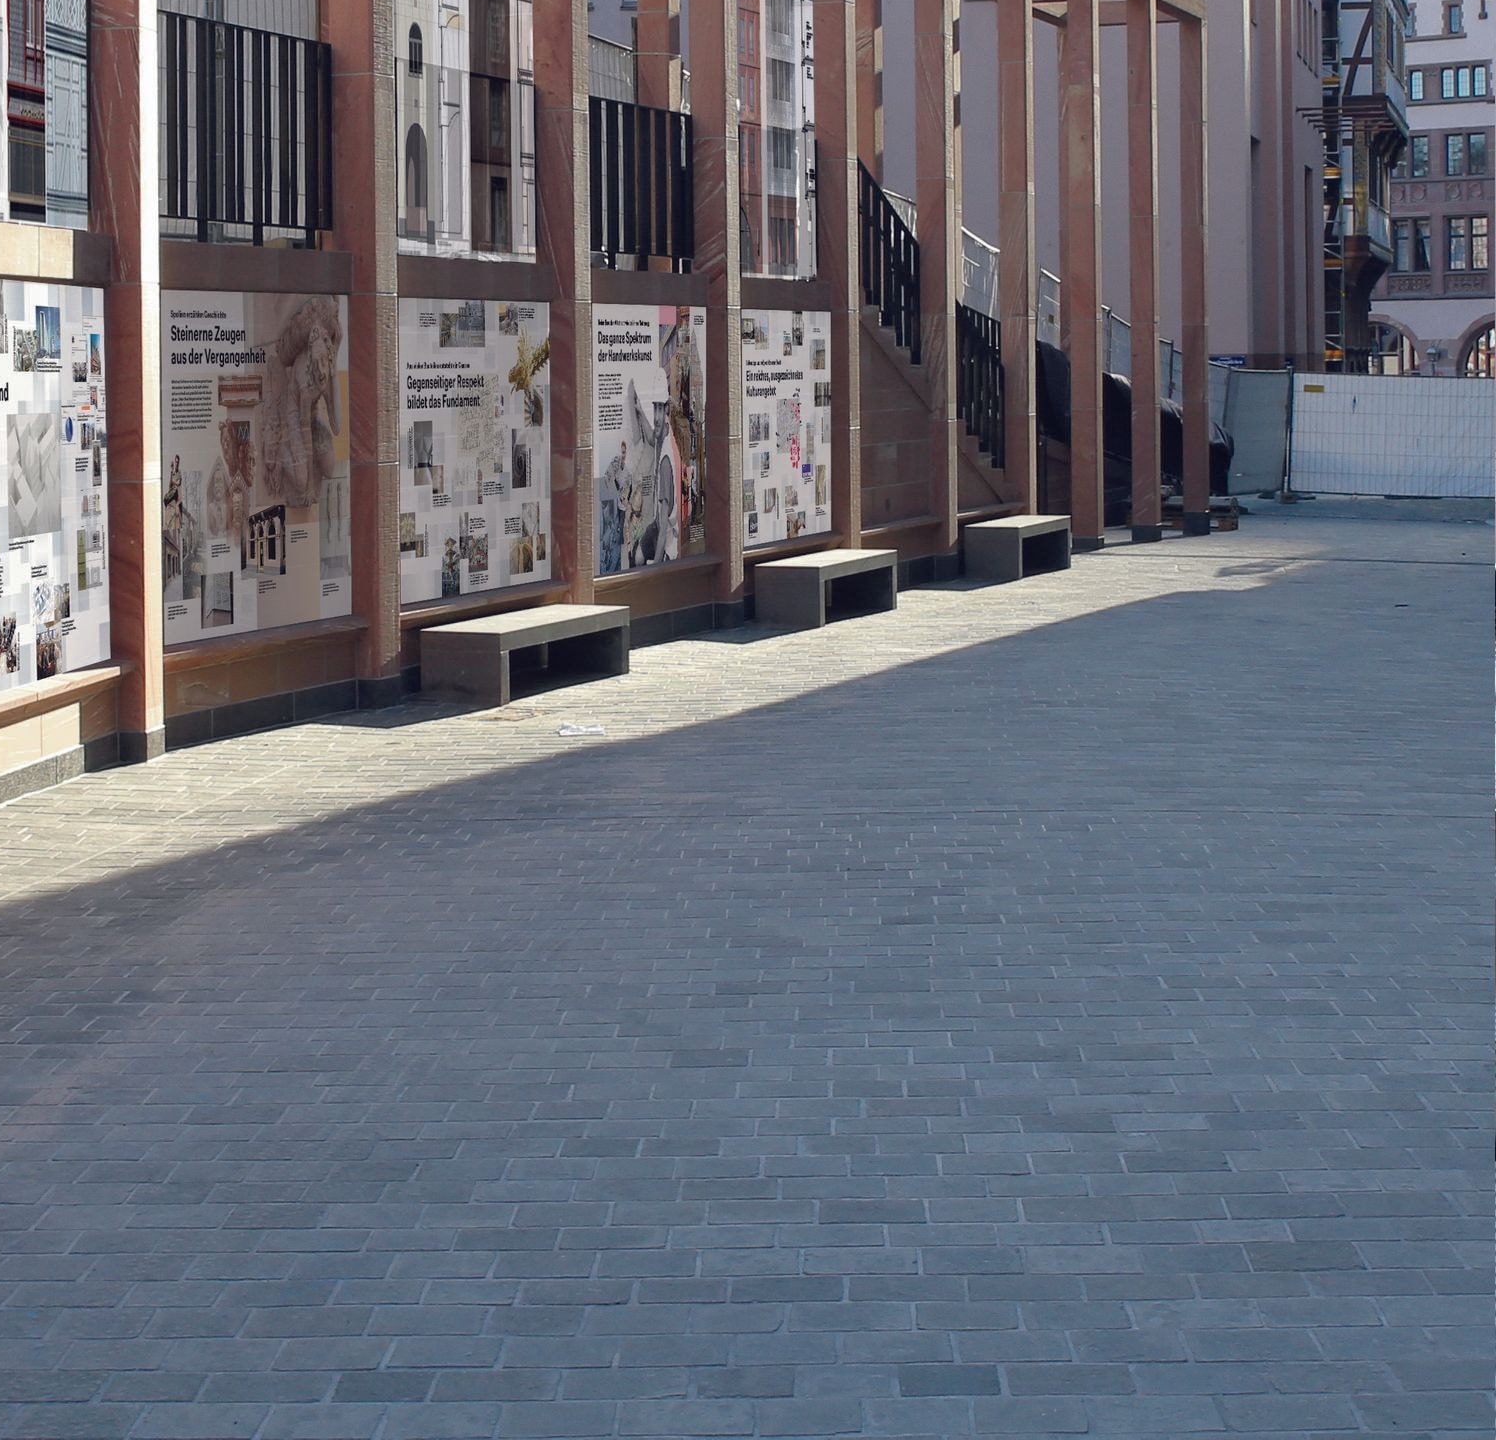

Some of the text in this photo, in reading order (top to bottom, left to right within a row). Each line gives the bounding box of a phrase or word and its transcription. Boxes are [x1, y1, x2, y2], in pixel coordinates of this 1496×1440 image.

[171, 325, 246, 344] Steinerne Zeugen
[598, 331, 651, 346] Das ganze Spektrum
[171, 348, 266, 367] aus der Vergangenheit
[598, 349, 652, 362] der Handwerkskunst
[407, 374, 484, 392] Gegenseitiger Respekt
[746, 386, 776, 398] Kulturangebot
[407, 394, 480, 409] bildet das Fundament
